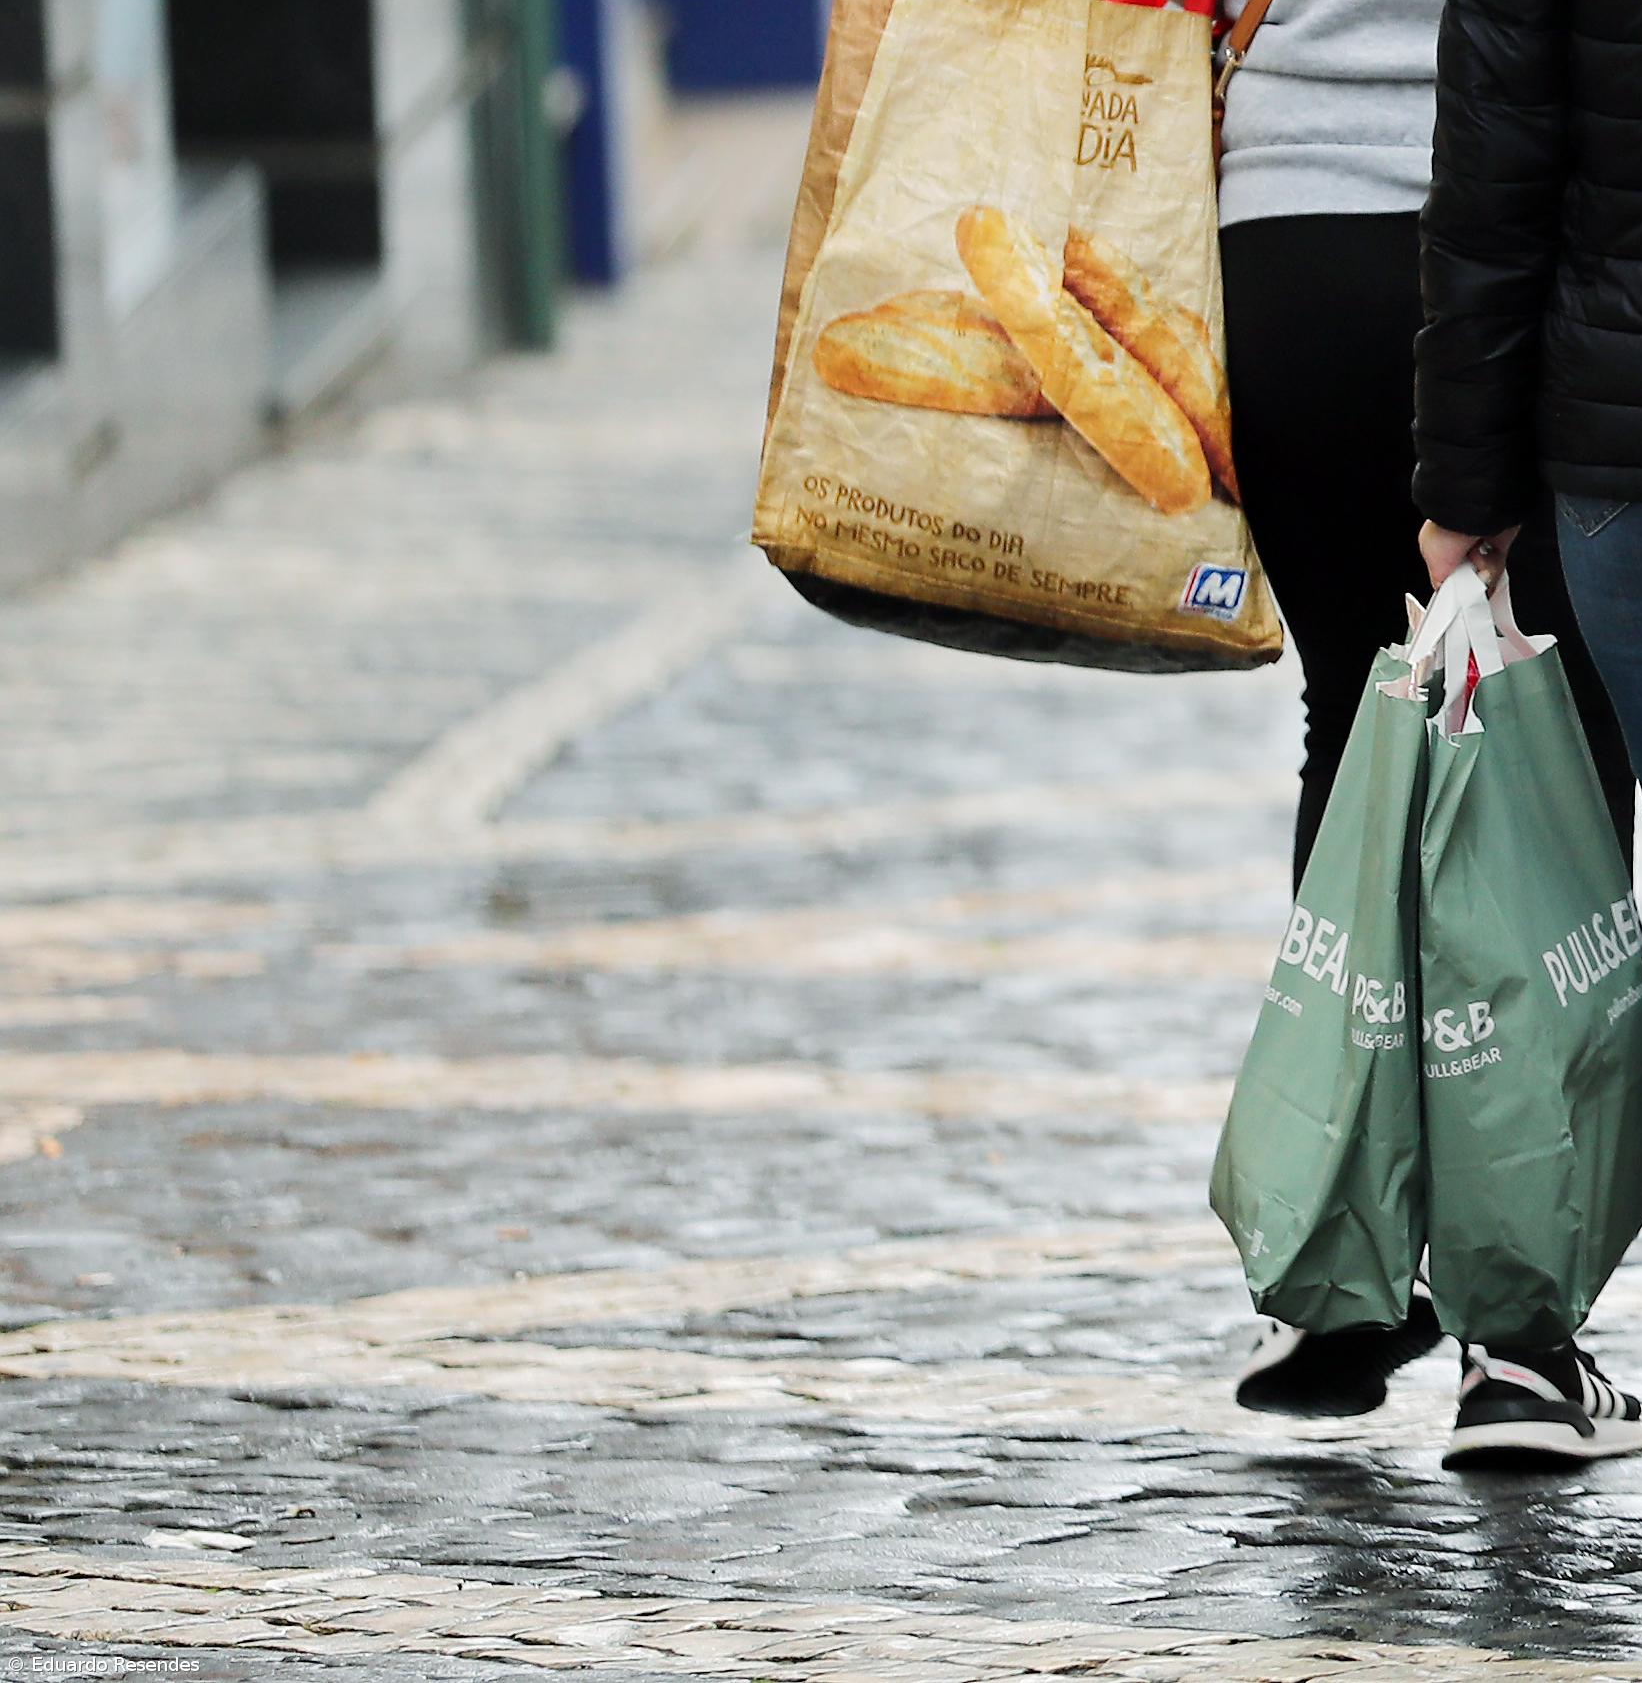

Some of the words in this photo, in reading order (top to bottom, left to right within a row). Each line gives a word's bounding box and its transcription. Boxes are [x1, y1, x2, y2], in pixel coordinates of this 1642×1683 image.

[796, 504, 828, 530] NO
[835, 520, 920, 559] MESMO
[929, 546, 986, 573] SACO
[993, 560, 1023, 585] DE
[803, 475, 831, 499] OS
[836, 485, 945, 537] PRODUTOS
[952, 522, 981, 543] DO
[989, 530, 1025, 558] DIA
[1352, 973, 1406, 1024] P&B
